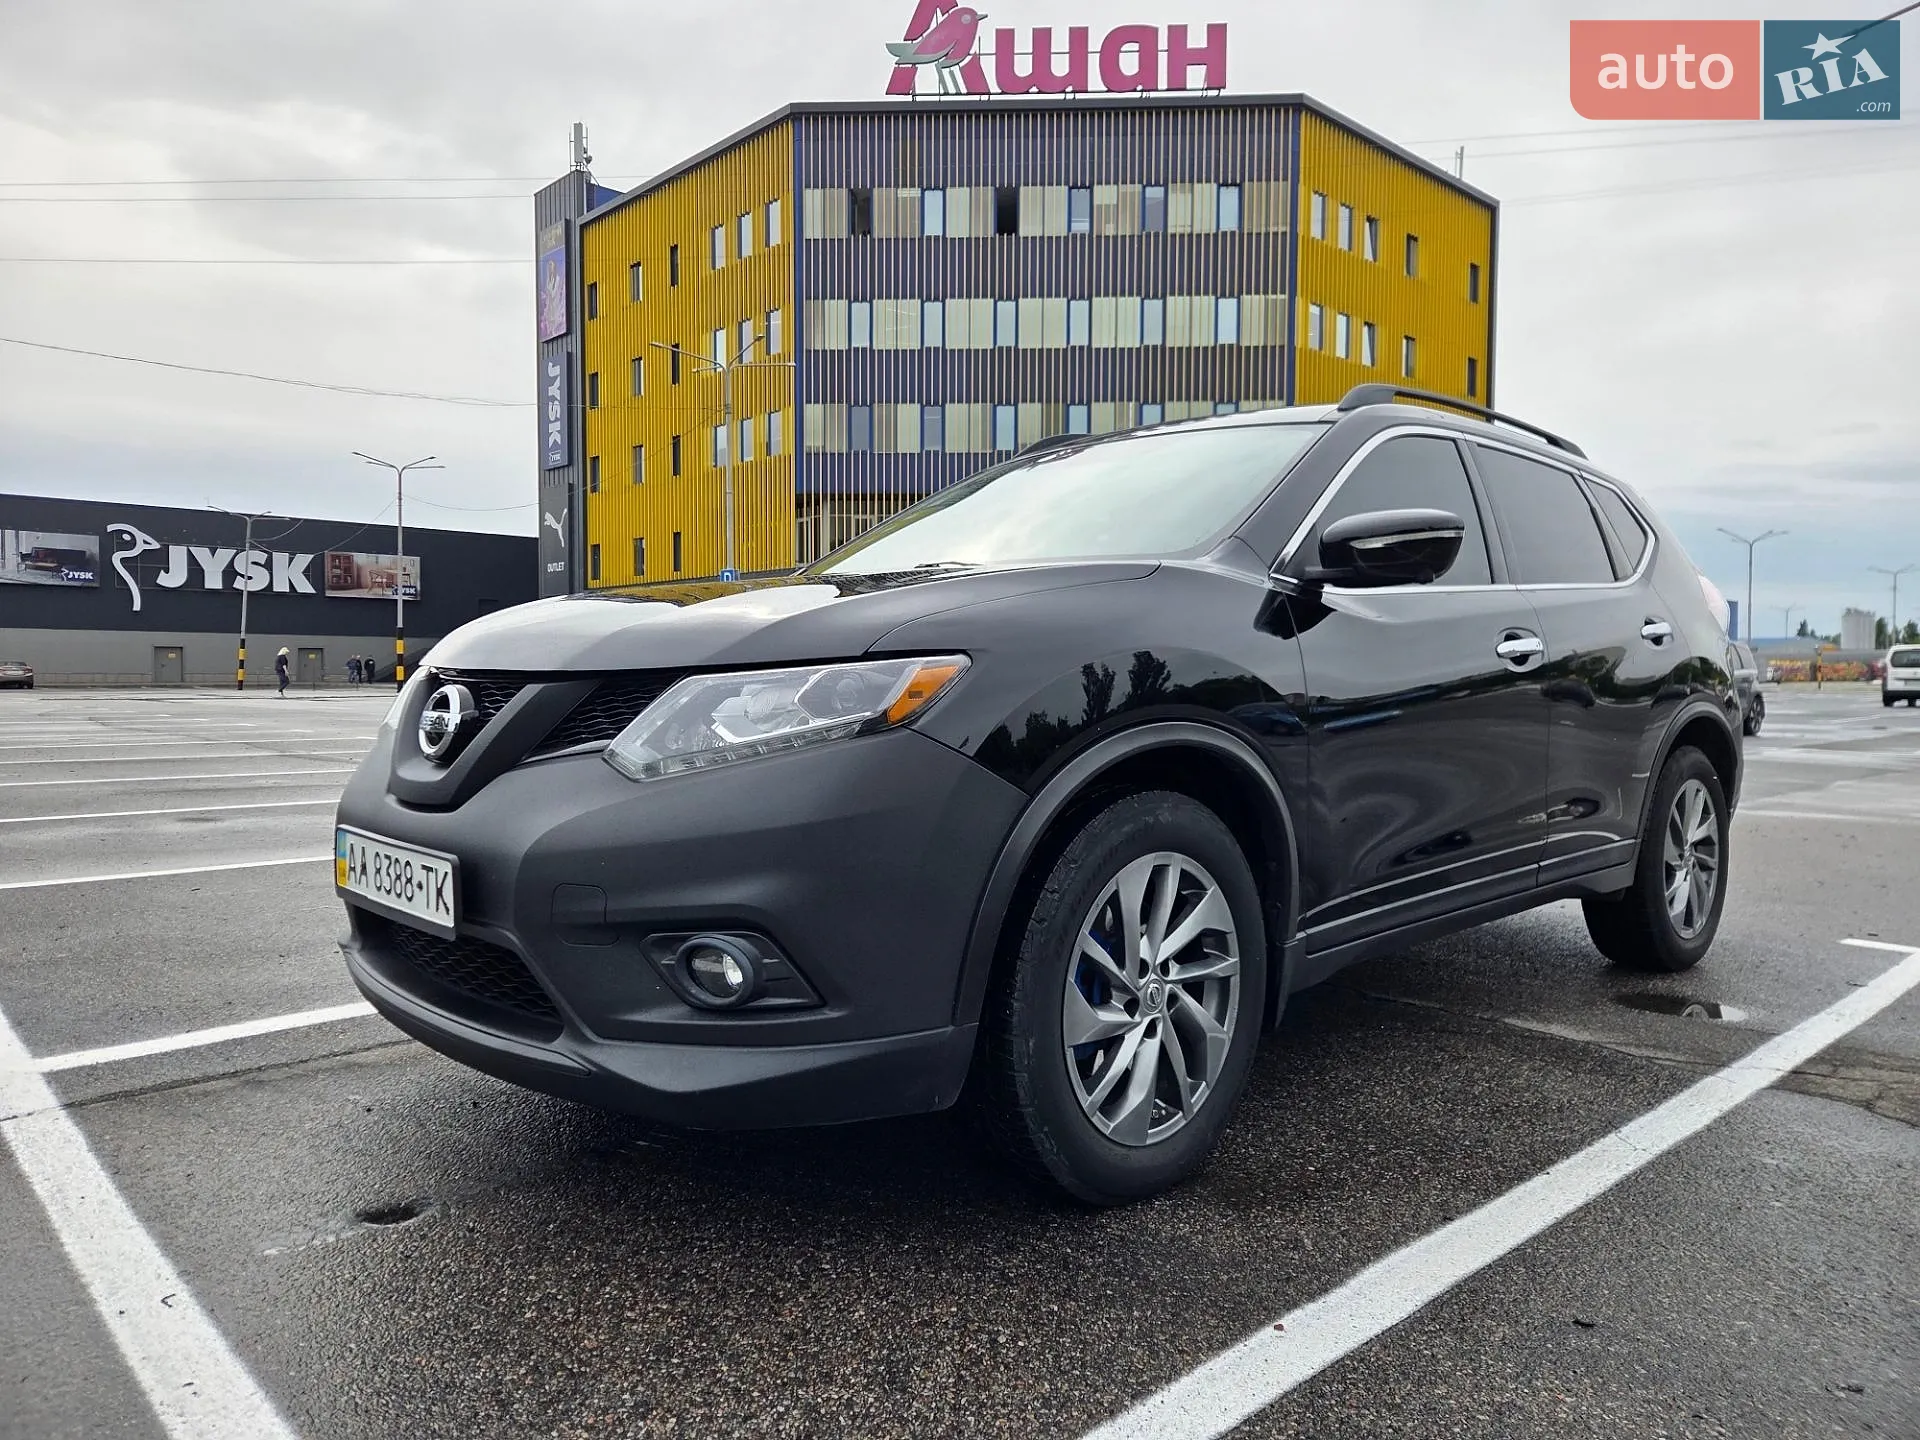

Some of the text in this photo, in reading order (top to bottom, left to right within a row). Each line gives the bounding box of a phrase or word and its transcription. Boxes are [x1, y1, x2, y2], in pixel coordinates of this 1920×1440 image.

[886, 0, 1228, 95] Ашан
[547, 361, 562, 449] JYSK
[67, 571, 94, 580] JYSK
[156, 545, 317, 594] JYSK
[547, 561, 565, 573] OUTLET
[347, 842, 369, 888] AA
